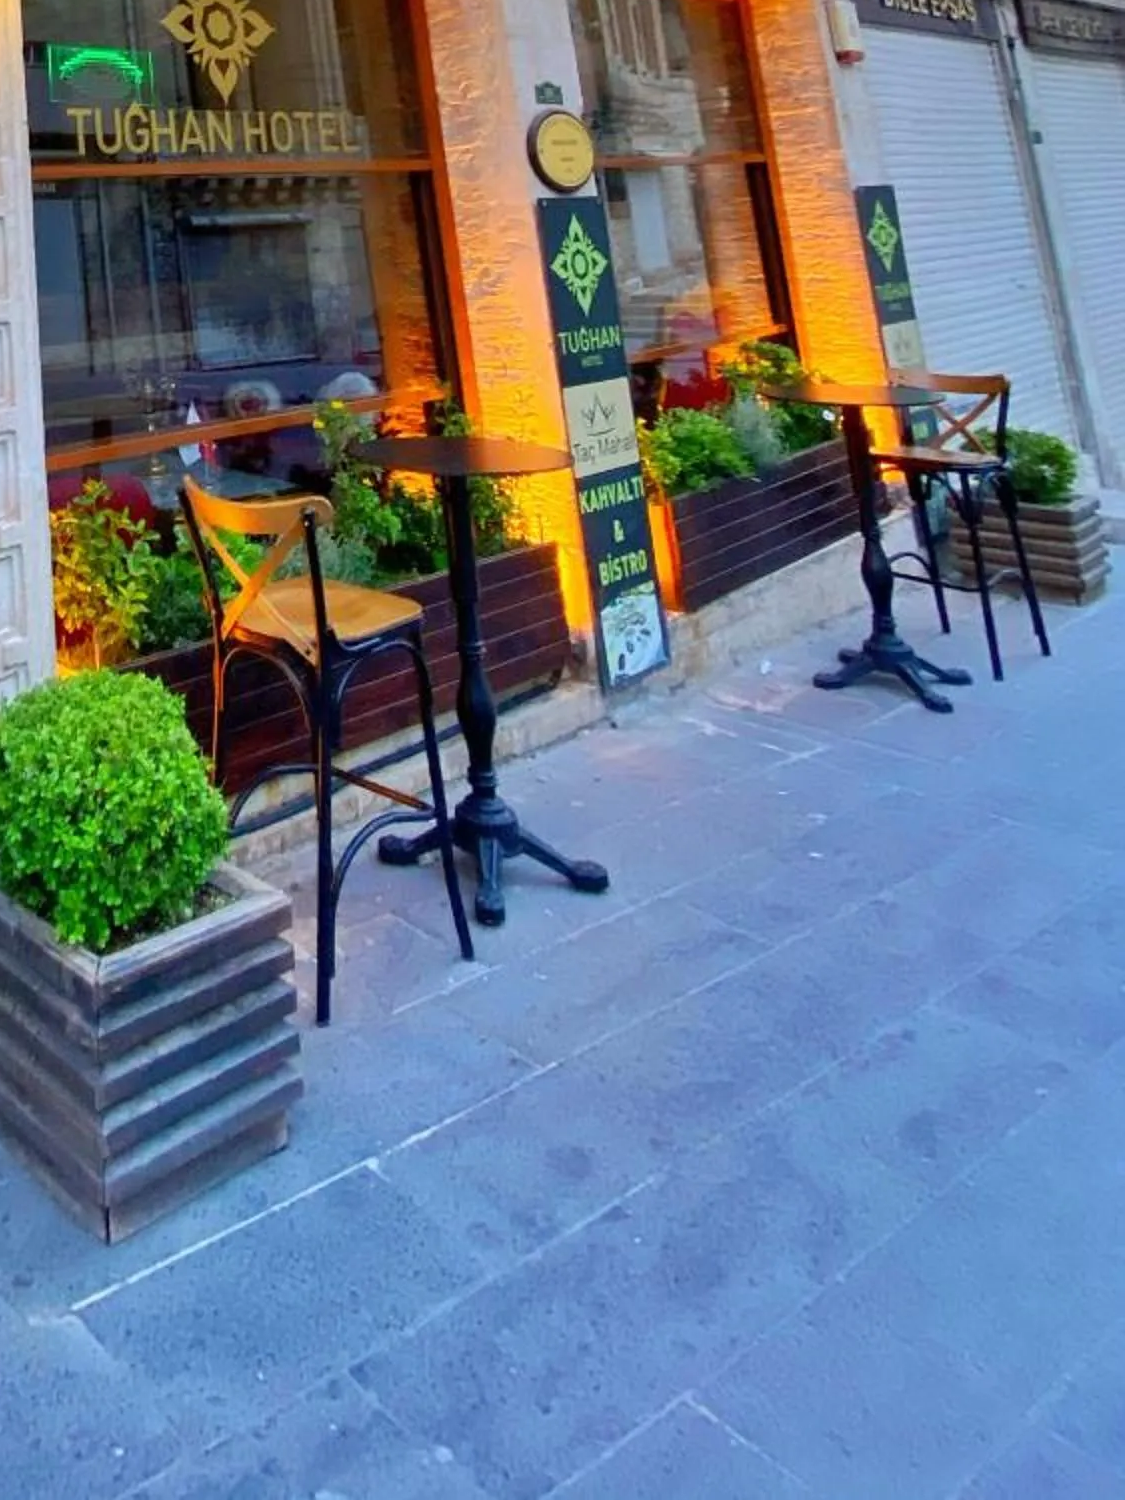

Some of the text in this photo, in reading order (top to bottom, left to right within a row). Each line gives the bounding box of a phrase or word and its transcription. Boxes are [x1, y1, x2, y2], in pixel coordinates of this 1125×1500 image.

[242, 110, 361, 154] HOTEL
[579, 475, 645, 514] KAHVALTI
[612, 519, 624, 543] &
